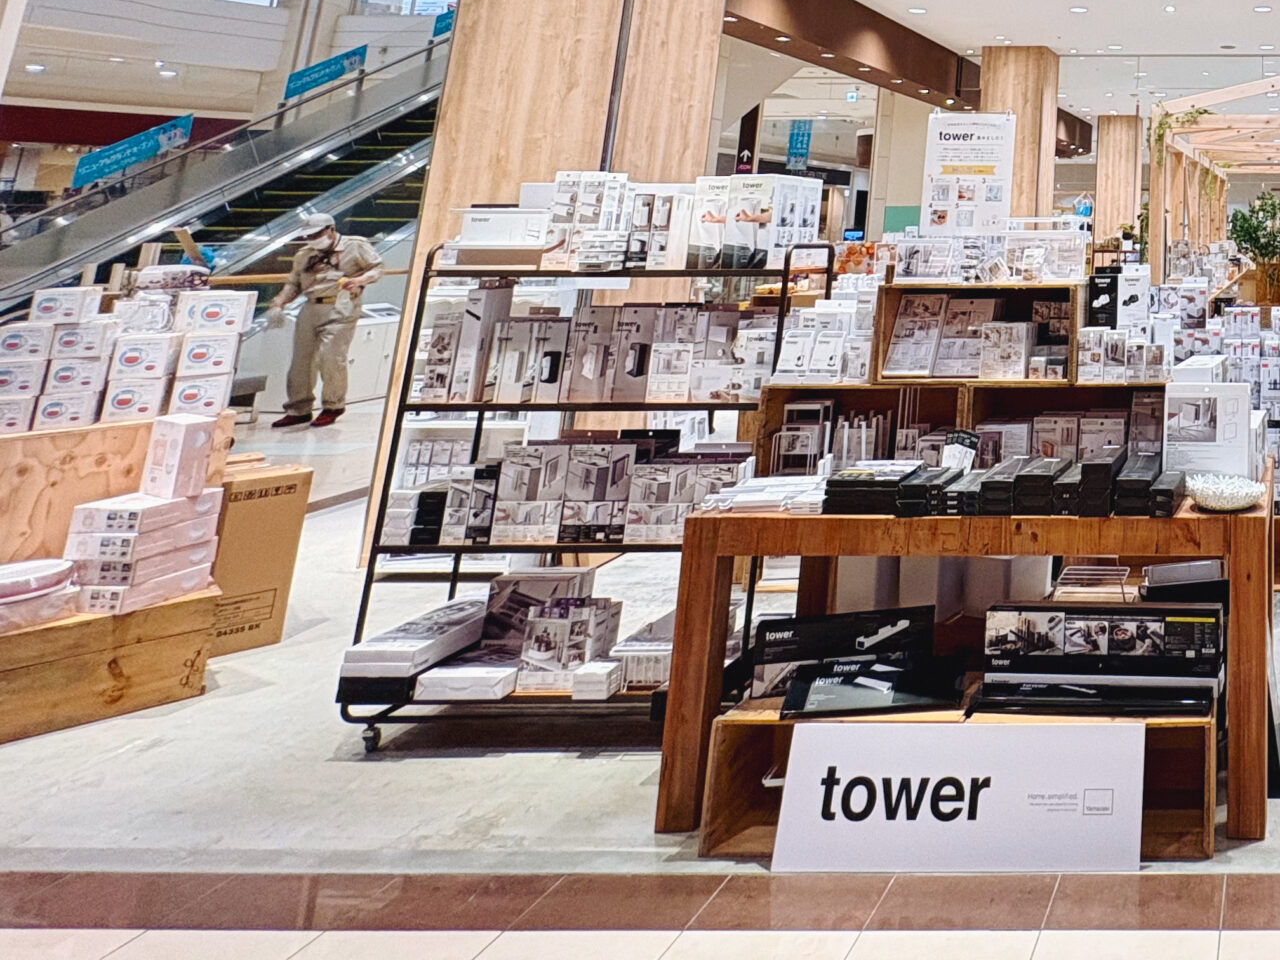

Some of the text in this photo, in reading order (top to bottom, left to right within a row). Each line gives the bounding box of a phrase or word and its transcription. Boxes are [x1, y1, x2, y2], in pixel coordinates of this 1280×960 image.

[939, 131, 976, 141] tower
[766, 630, 794, 641] tower
[992, 658, 1010, 666] tower
[833, 663, 861, 673] tower
[815, 676, 844, 686] tower
[820, 766, 992, 822] tower
